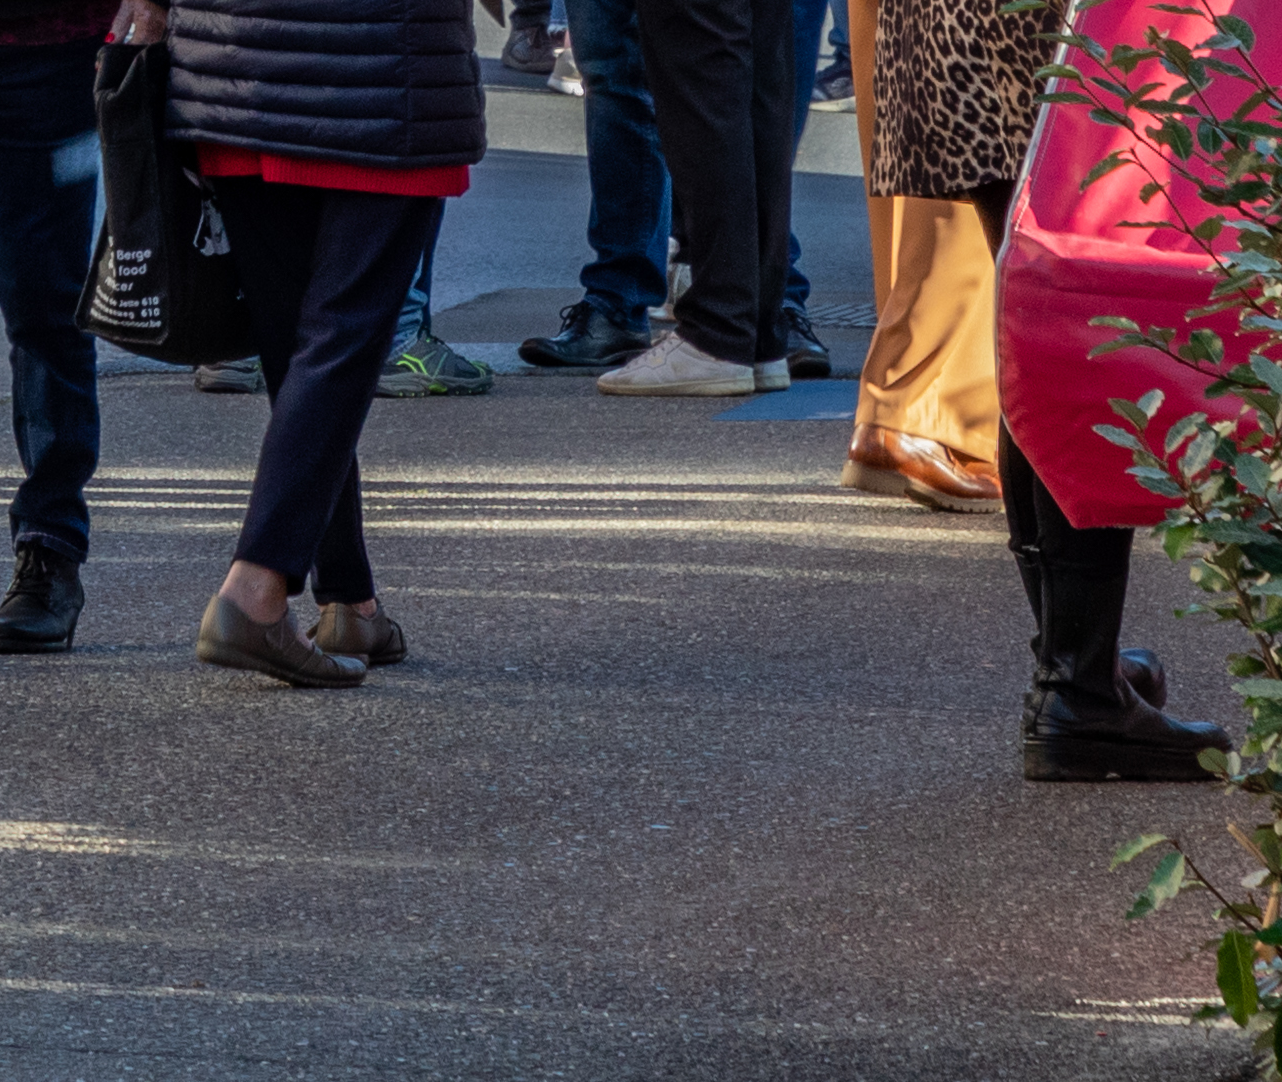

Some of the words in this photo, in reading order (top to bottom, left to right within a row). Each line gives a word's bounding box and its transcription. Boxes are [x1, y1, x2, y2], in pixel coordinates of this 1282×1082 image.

[116, 249, 152, 262] Berge
[118, 263, 147, 276] food
[141, 296, 159, 306] 610
[140, 307, 160, 318] 610
